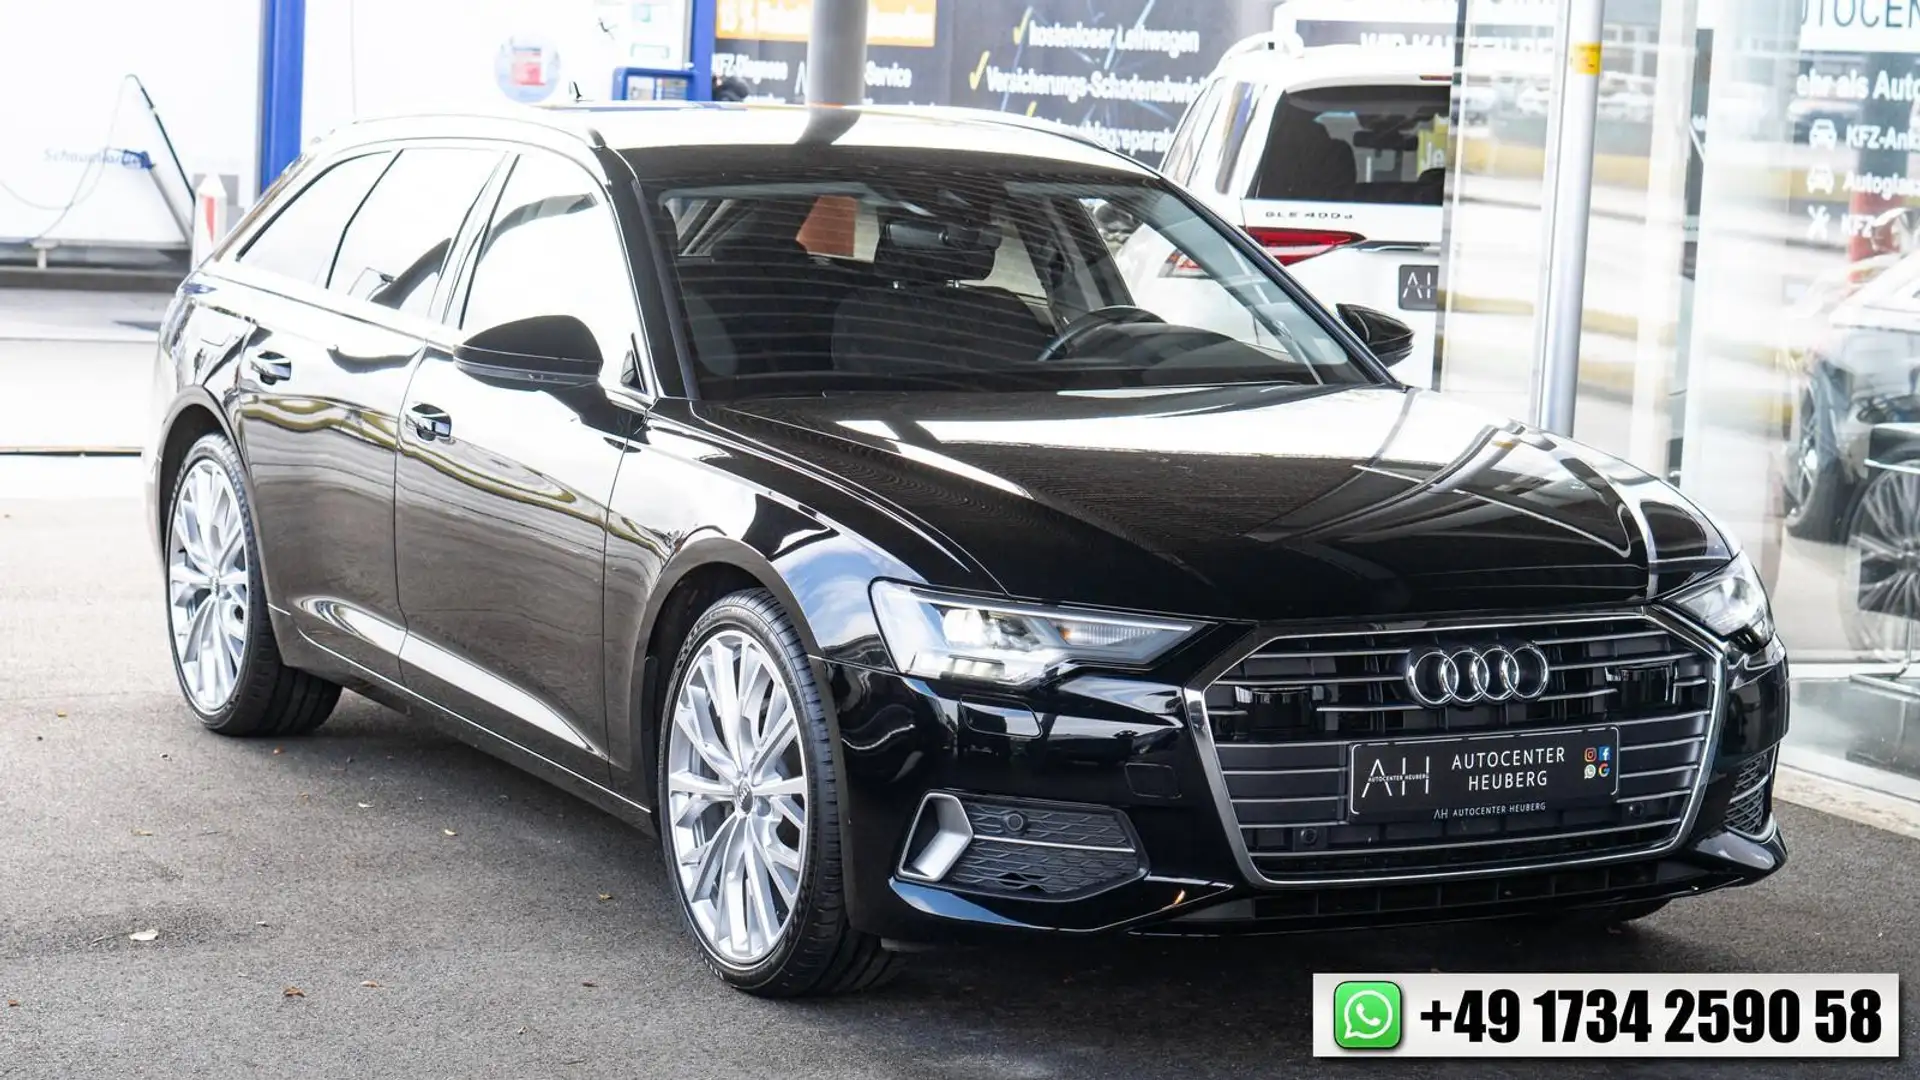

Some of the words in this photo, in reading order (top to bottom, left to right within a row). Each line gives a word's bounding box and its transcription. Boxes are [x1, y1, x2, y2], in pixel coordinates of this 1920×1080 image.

[1116, 24, 1200, 58] Leihwagen
[1451, 746, 1565, 770] AUTOCENTER
[1361, 755, 1430, 798] AH
[1468, 770, 1548, 792] HEUBERG
[1452, 805, 1507, 817] AUTOCENTER
[1509, 801, 1547, 813] HEUBERG
